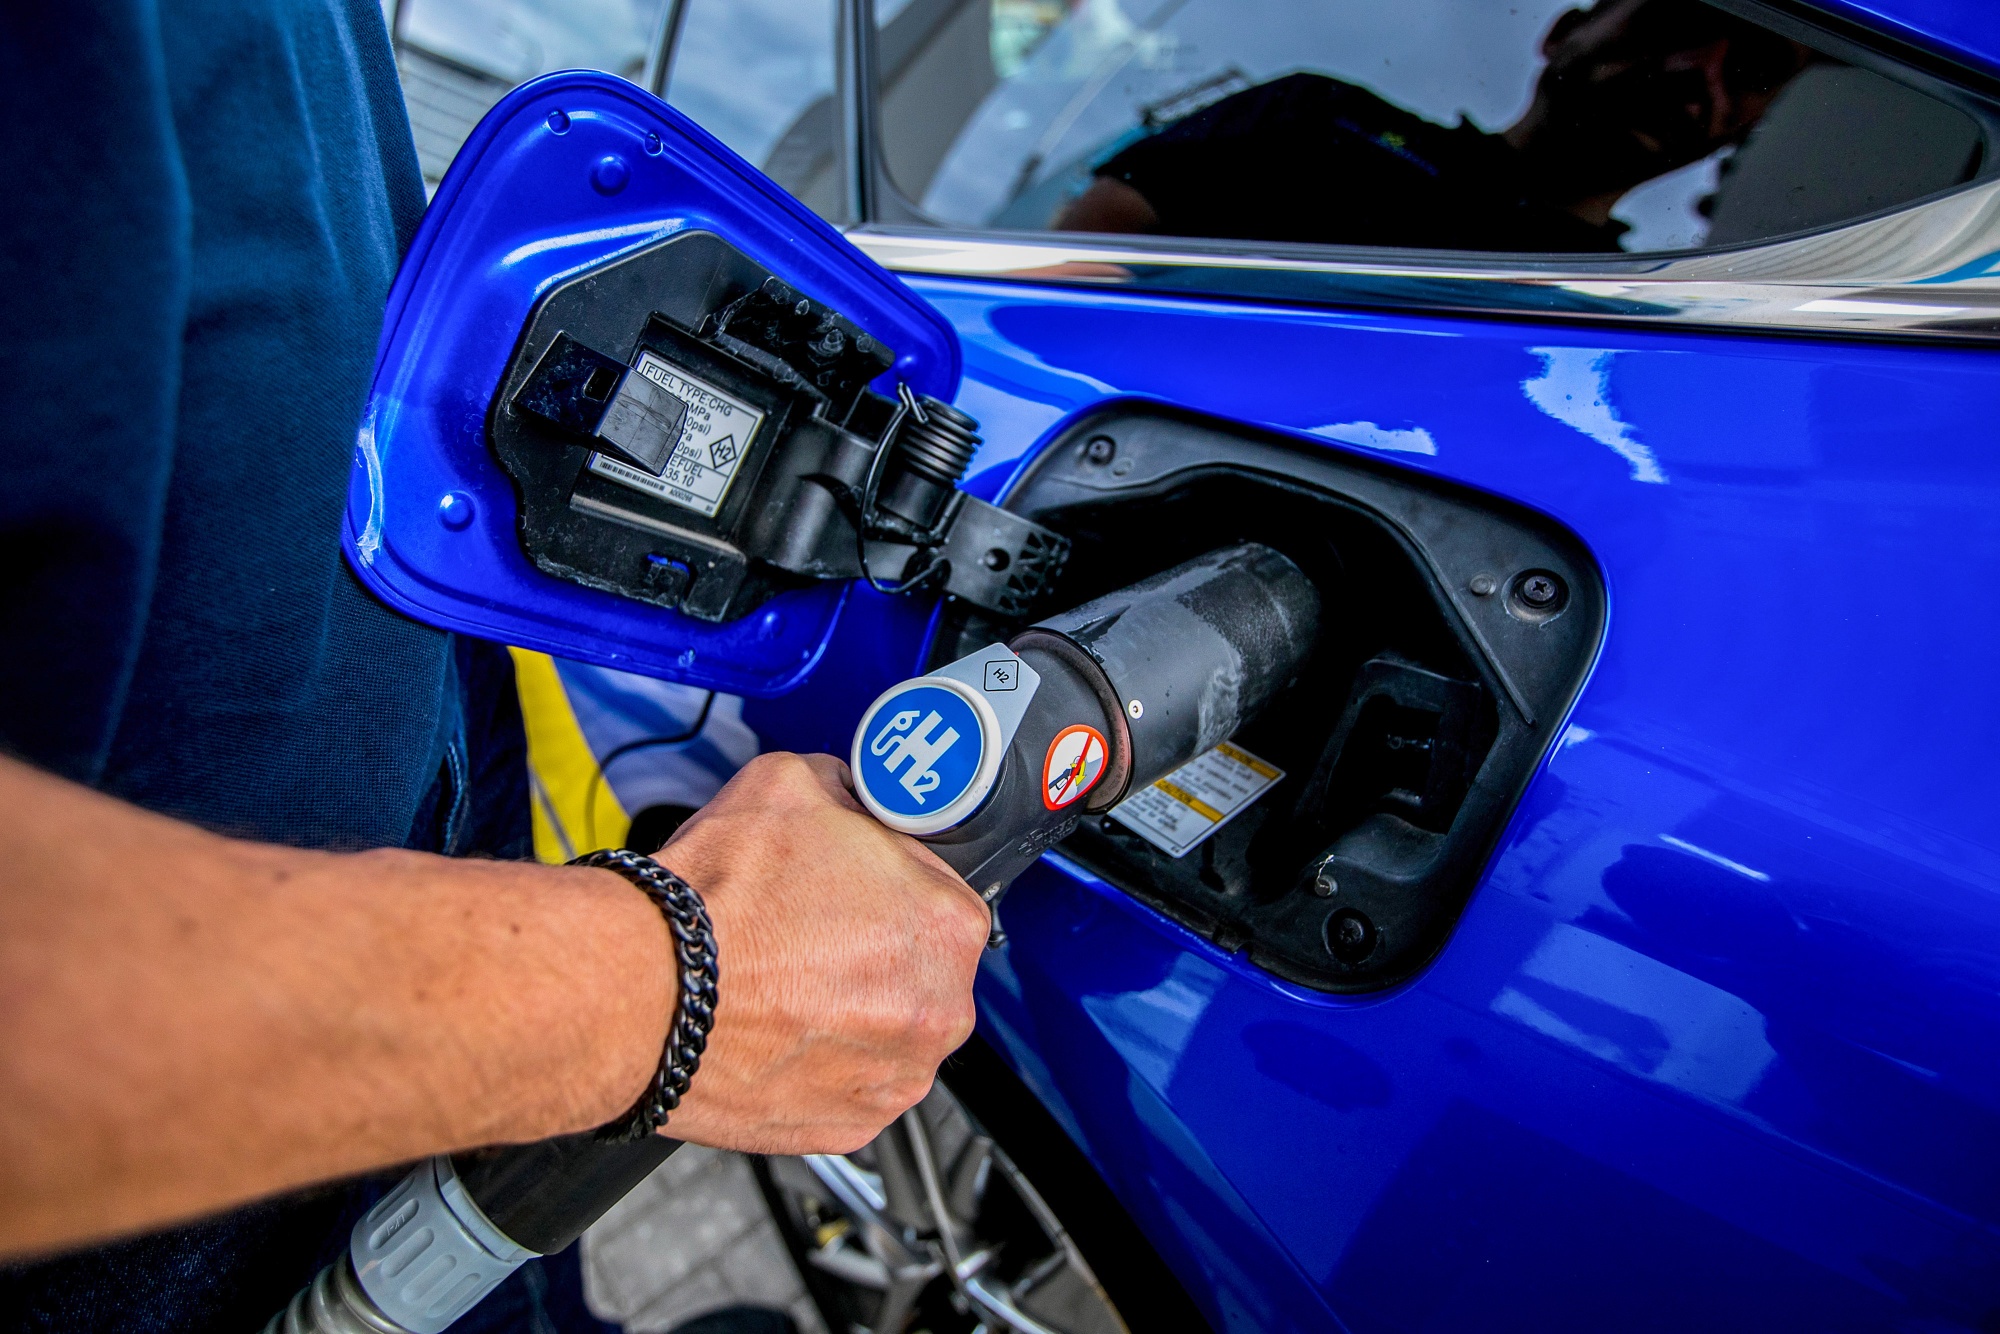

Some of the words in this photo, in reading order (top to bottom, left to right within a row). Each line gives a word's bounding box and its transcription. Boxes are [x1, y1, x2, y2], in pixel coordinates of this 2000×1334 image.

[646, 365, 675, 388] FUEL
[678, 381, 733, 417] TYPE:CHG
[714, 442, 732, 461] H2
[992, 667, 1010, 684] H2
[883, 709, 961, 806] H2
